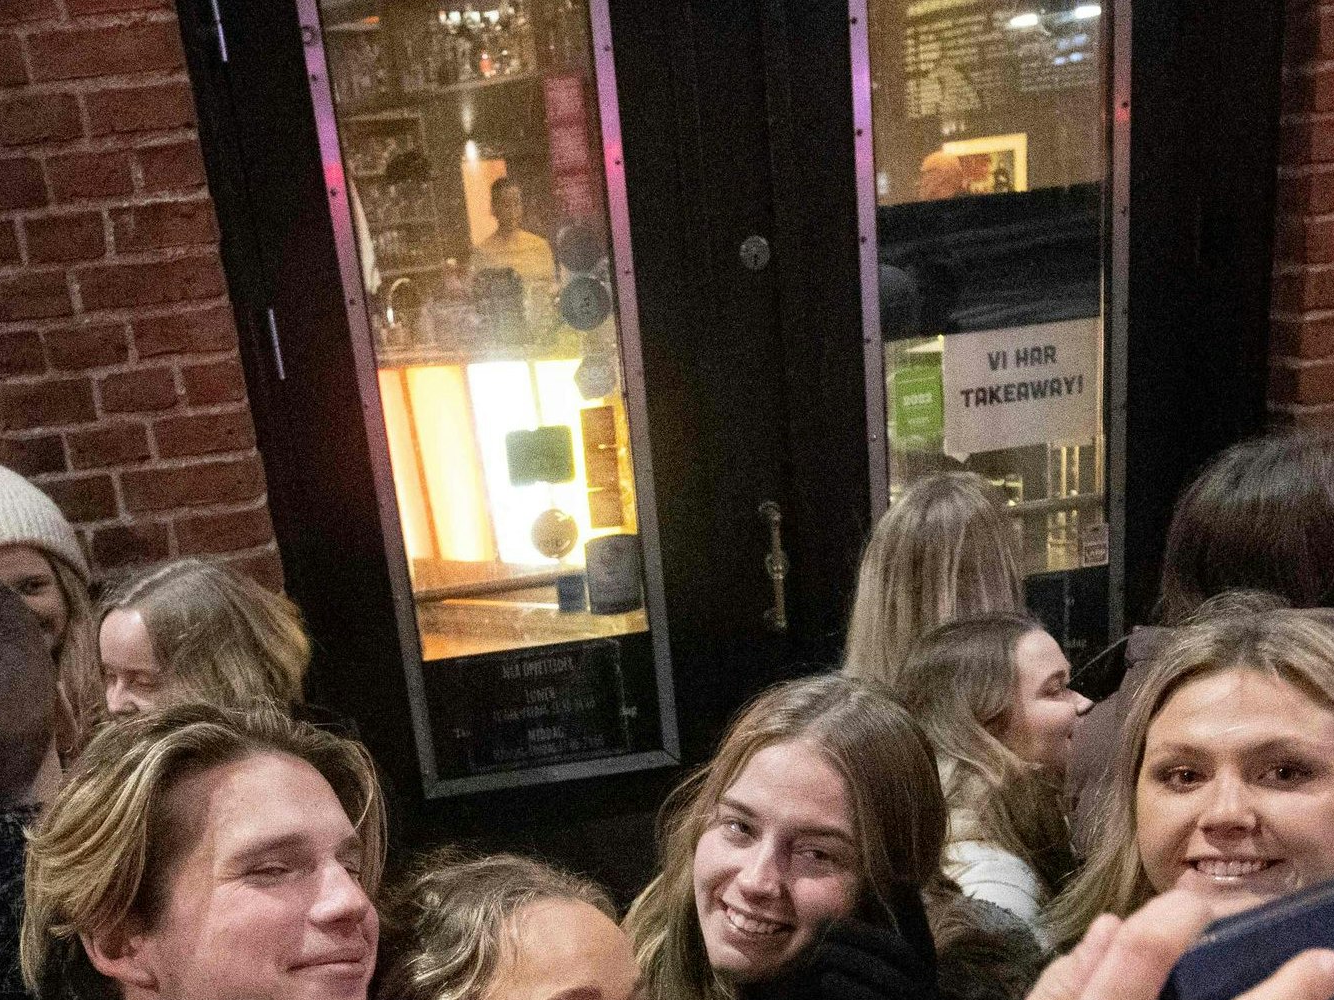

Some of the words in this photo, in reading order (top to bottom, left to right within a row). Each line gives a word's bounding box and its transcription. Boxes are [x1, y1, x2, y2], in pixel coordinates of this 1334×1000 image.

[987, 350, 1007, 371] VI
[1015, 345, 1057, 368] HAR
[960, 374, 1084, 408] TAKEAWAY!
